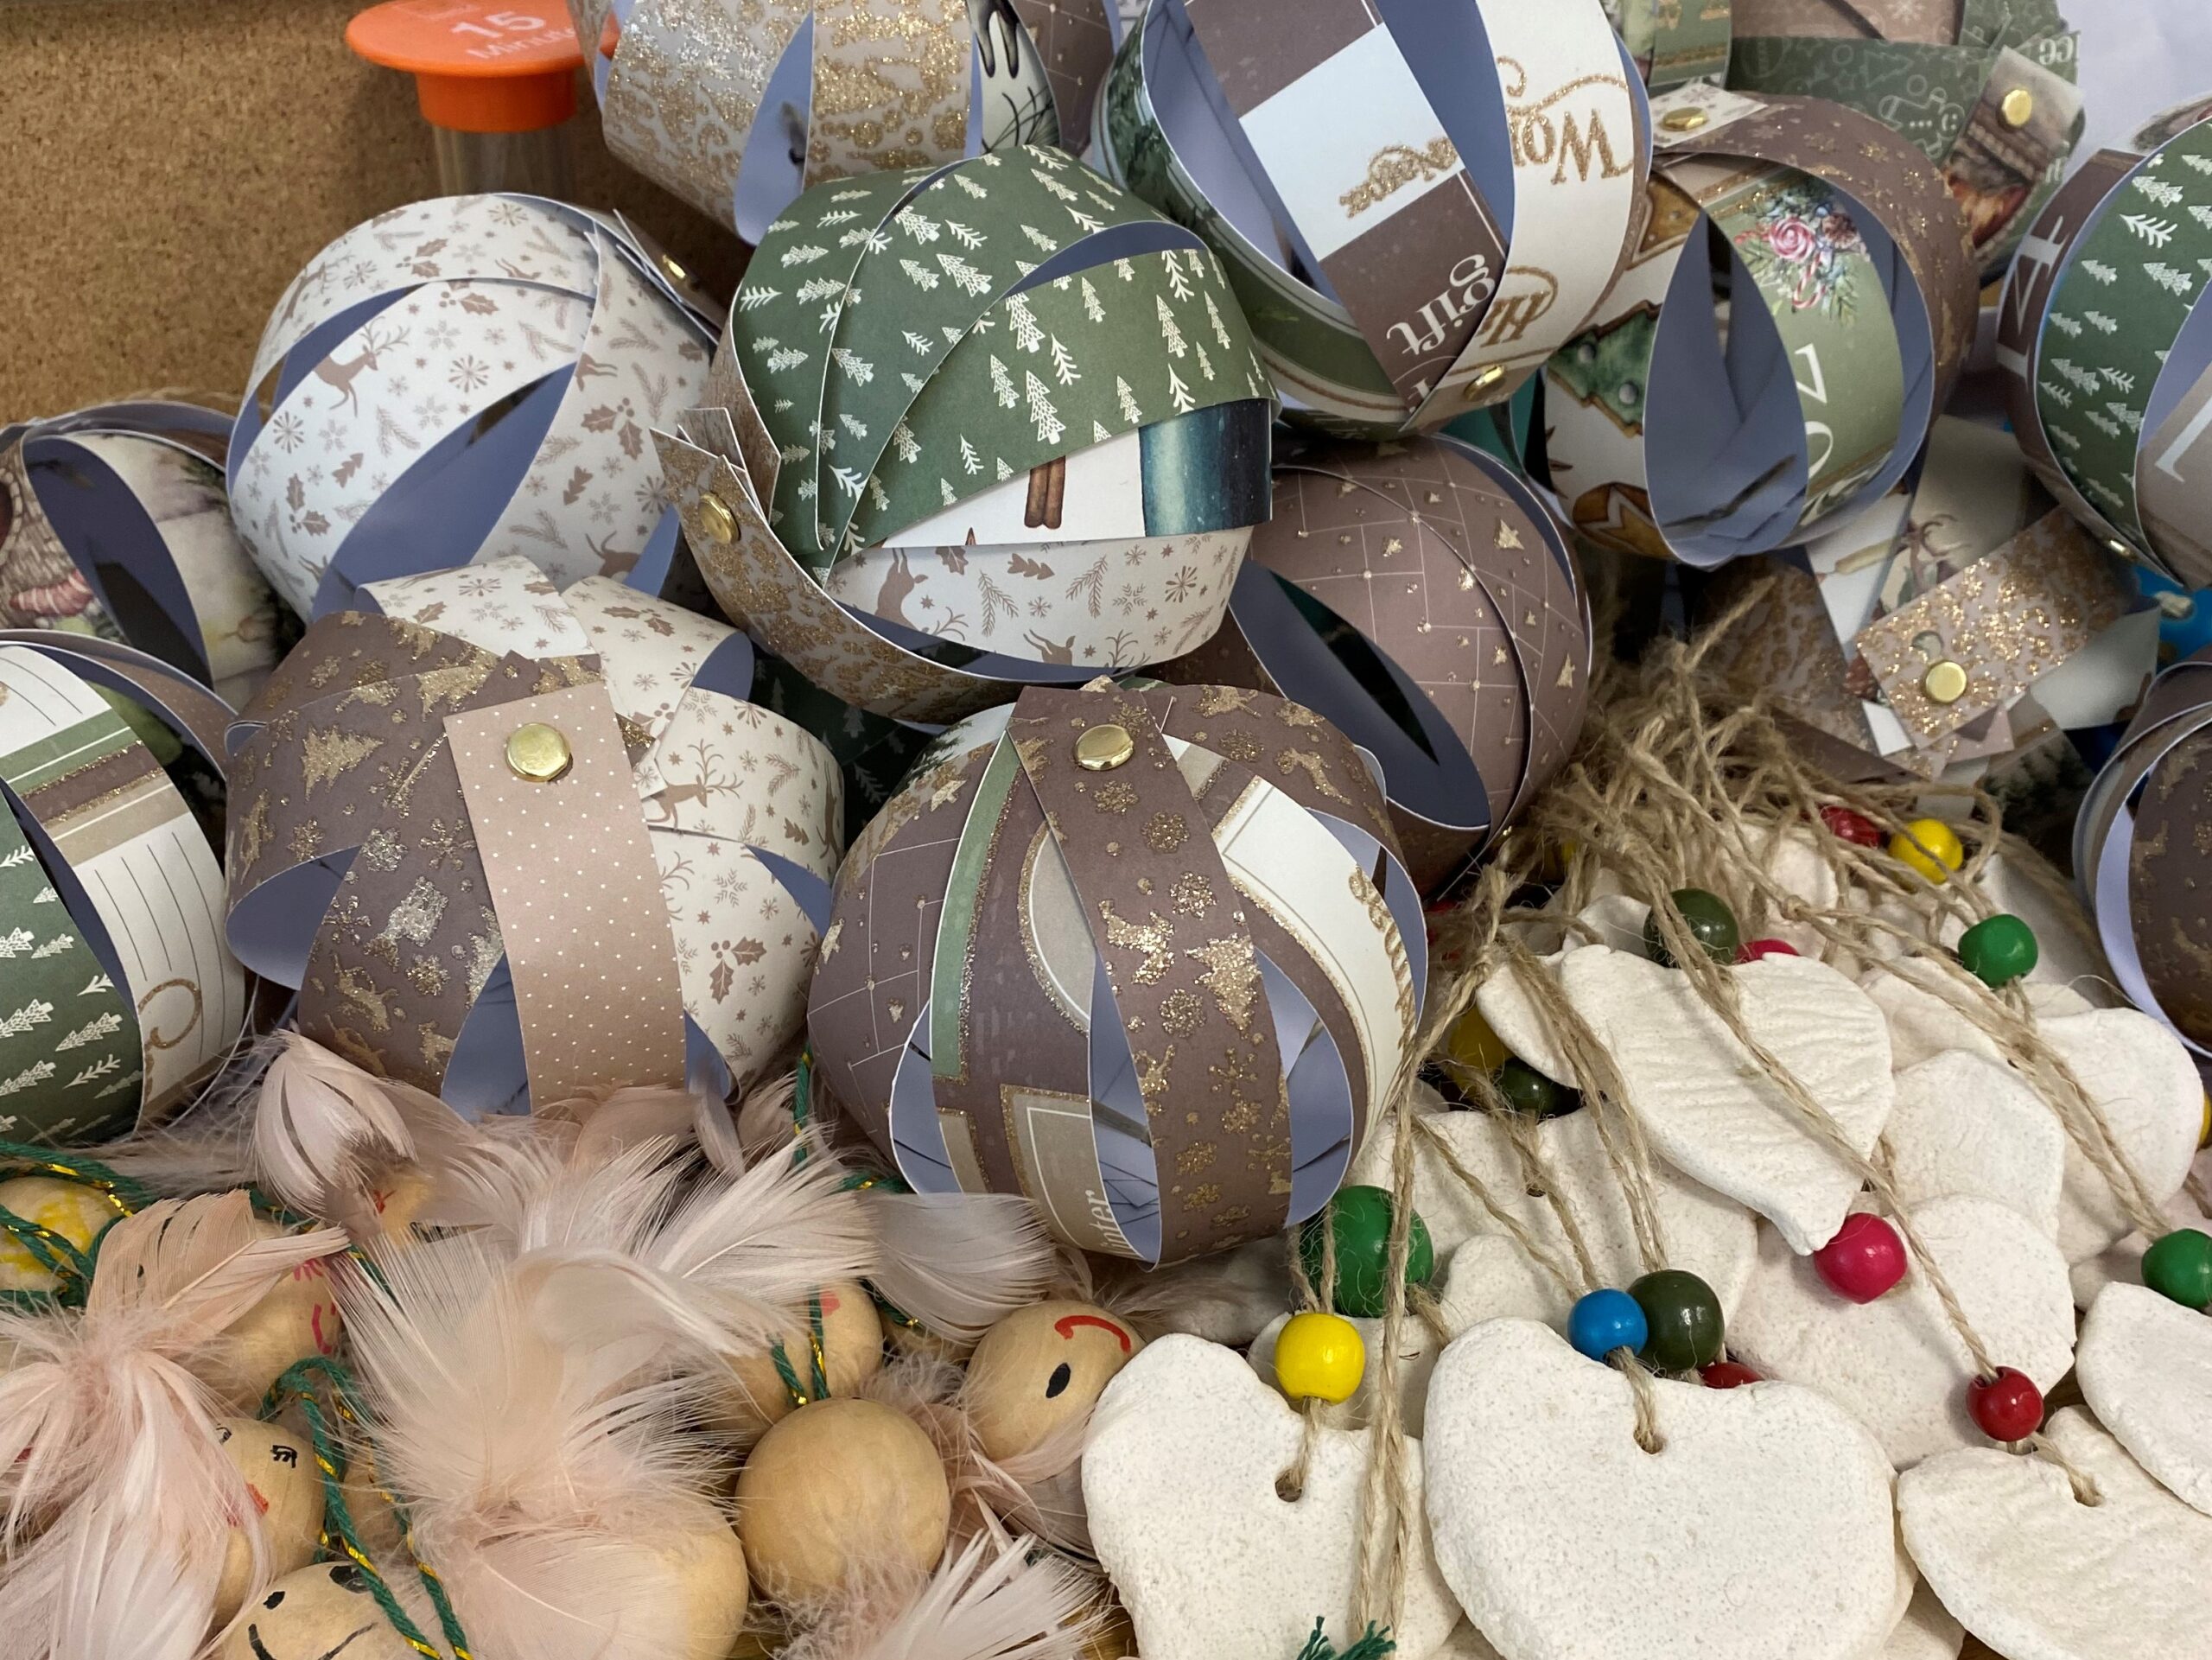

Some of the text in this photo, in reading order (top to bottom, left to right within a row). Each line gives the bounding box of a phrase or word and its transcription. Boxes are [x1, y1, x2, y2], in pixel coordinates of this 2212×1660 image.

[451, 11, 545, 38] 15
[466, 28, 577, 59] Minute
[1386, 253, 1497, 356] gift
